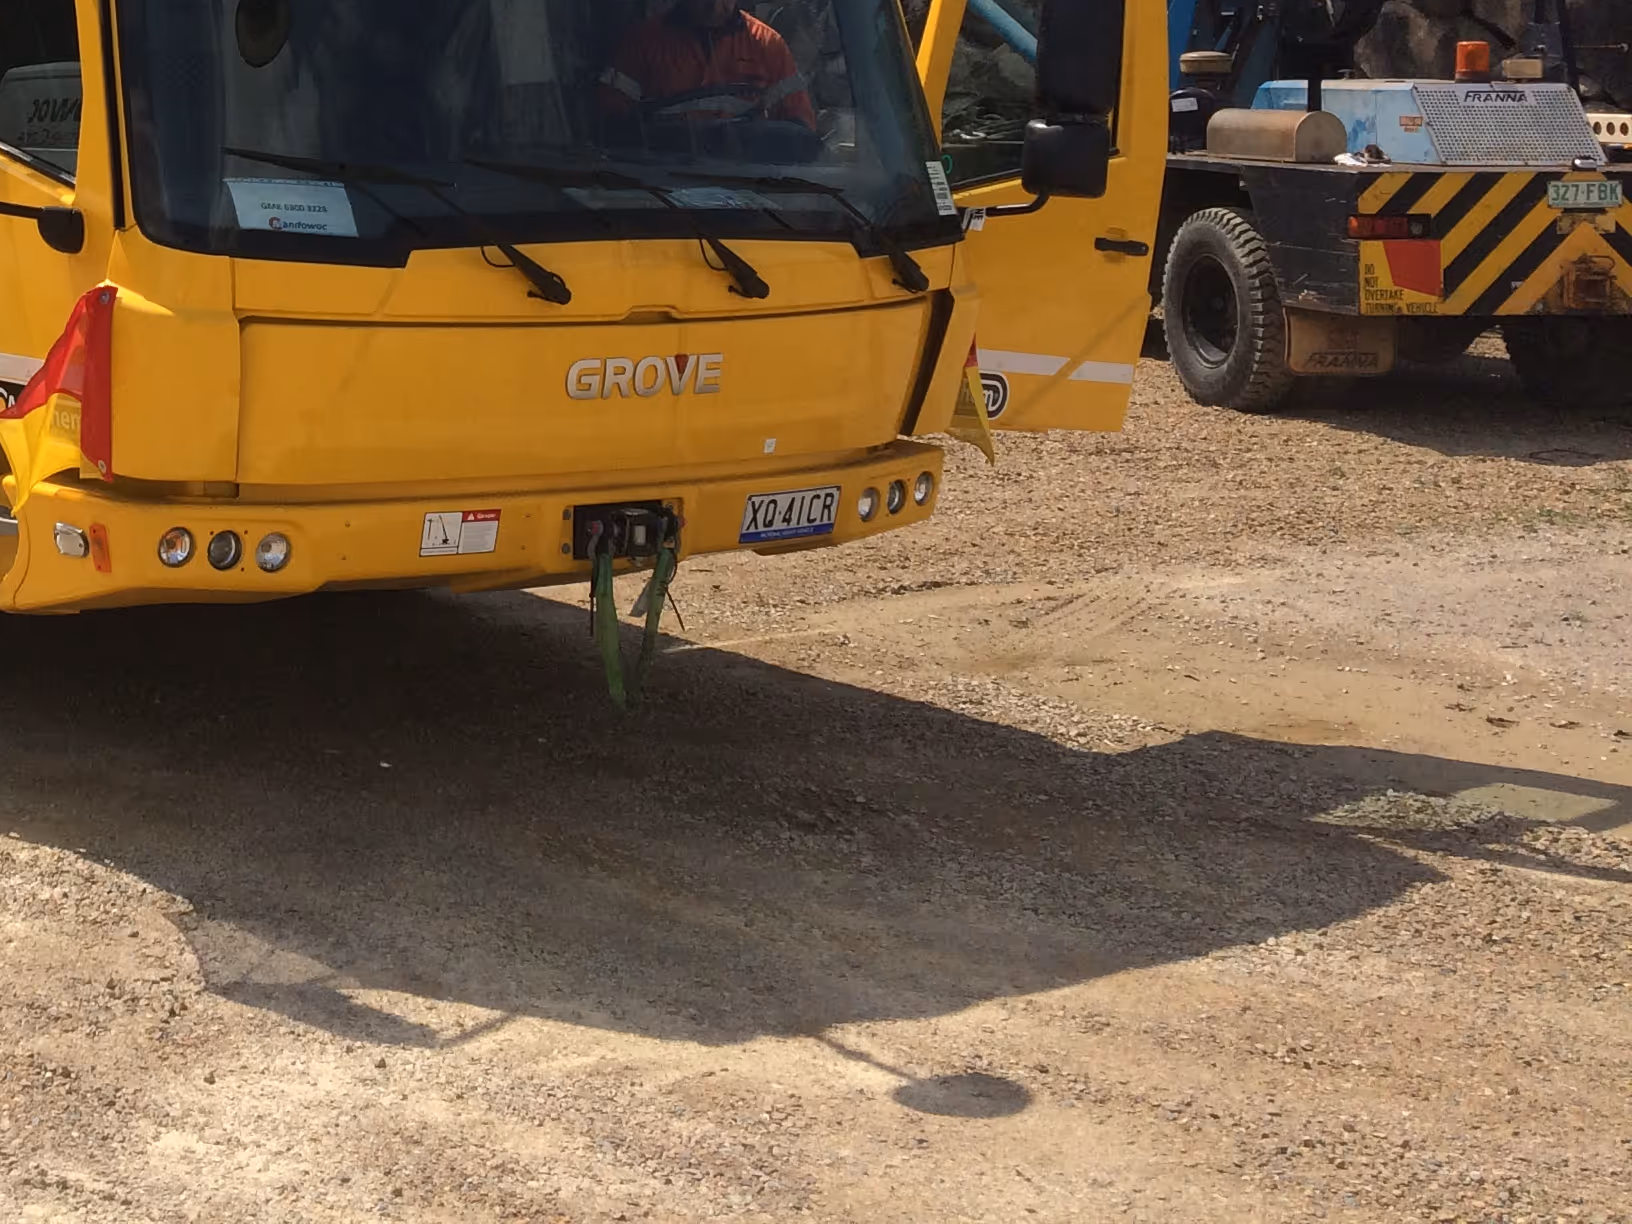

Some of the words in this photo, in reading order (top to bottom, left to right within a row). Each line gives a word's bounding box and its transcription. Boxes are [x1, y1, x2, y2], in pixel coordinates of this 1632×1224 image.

[1464, 90, 1528, 103] FRANNA
[1364, 289, 1405, 301] OVERTAKE
[567, 352, 724, 401] GROVE
